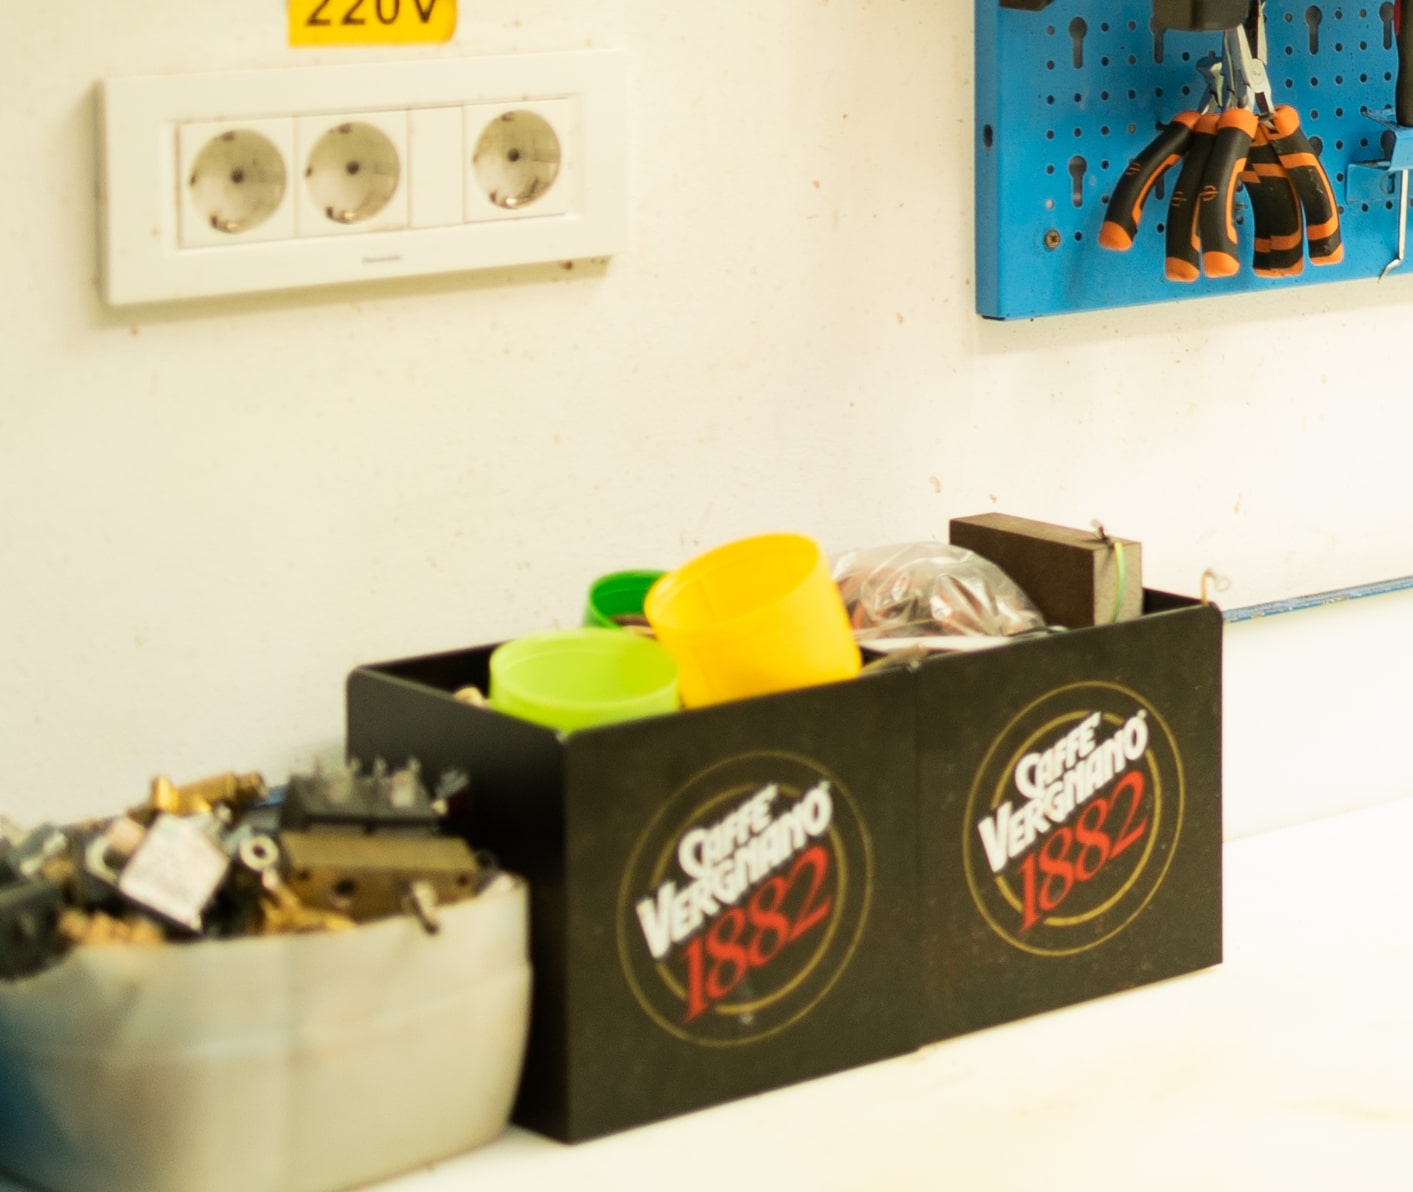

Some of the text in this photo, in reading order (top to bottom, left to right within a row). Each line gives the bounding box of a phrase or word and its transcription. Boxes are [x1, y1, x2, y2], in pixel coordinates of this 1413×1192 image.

[636, 786, 833, 959] VERGNANO
[977, 715, 1149, 873] VERGNANO
[1017, 770, 1149, 935] 1882
[683, 845, 832, 1024] 1882
